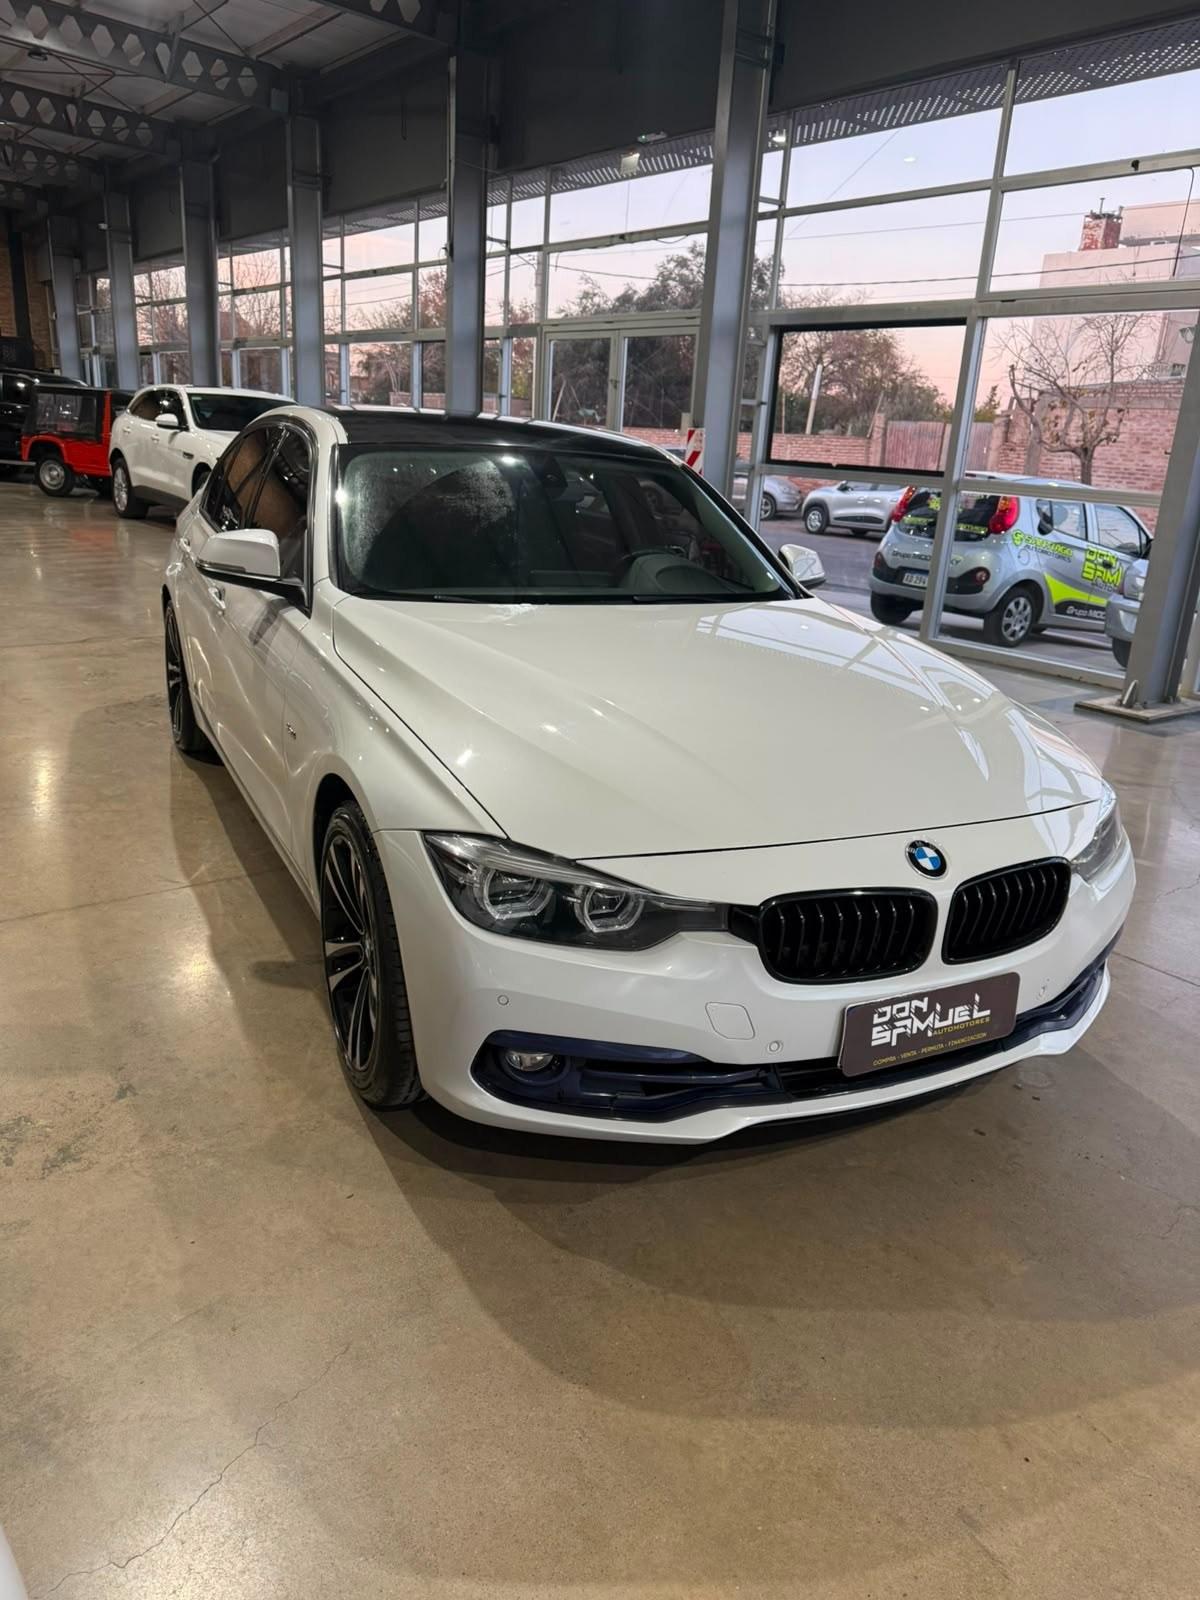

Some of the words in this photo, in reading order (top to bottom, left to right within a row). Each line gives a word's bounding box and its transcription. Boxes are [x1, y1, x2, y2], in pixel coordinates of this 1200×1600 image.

[871, 993, 991, 1047] SAMUEL
[872, 996, 929, 1024] DON
[932, 1016, 991, 1036] AUTOMOTORES
[872, 1056, 896, 1066] COMPRA
[901, 1050, 917, 1059] VENTA
[921, 1043, 944, 1054] PERMUTA
